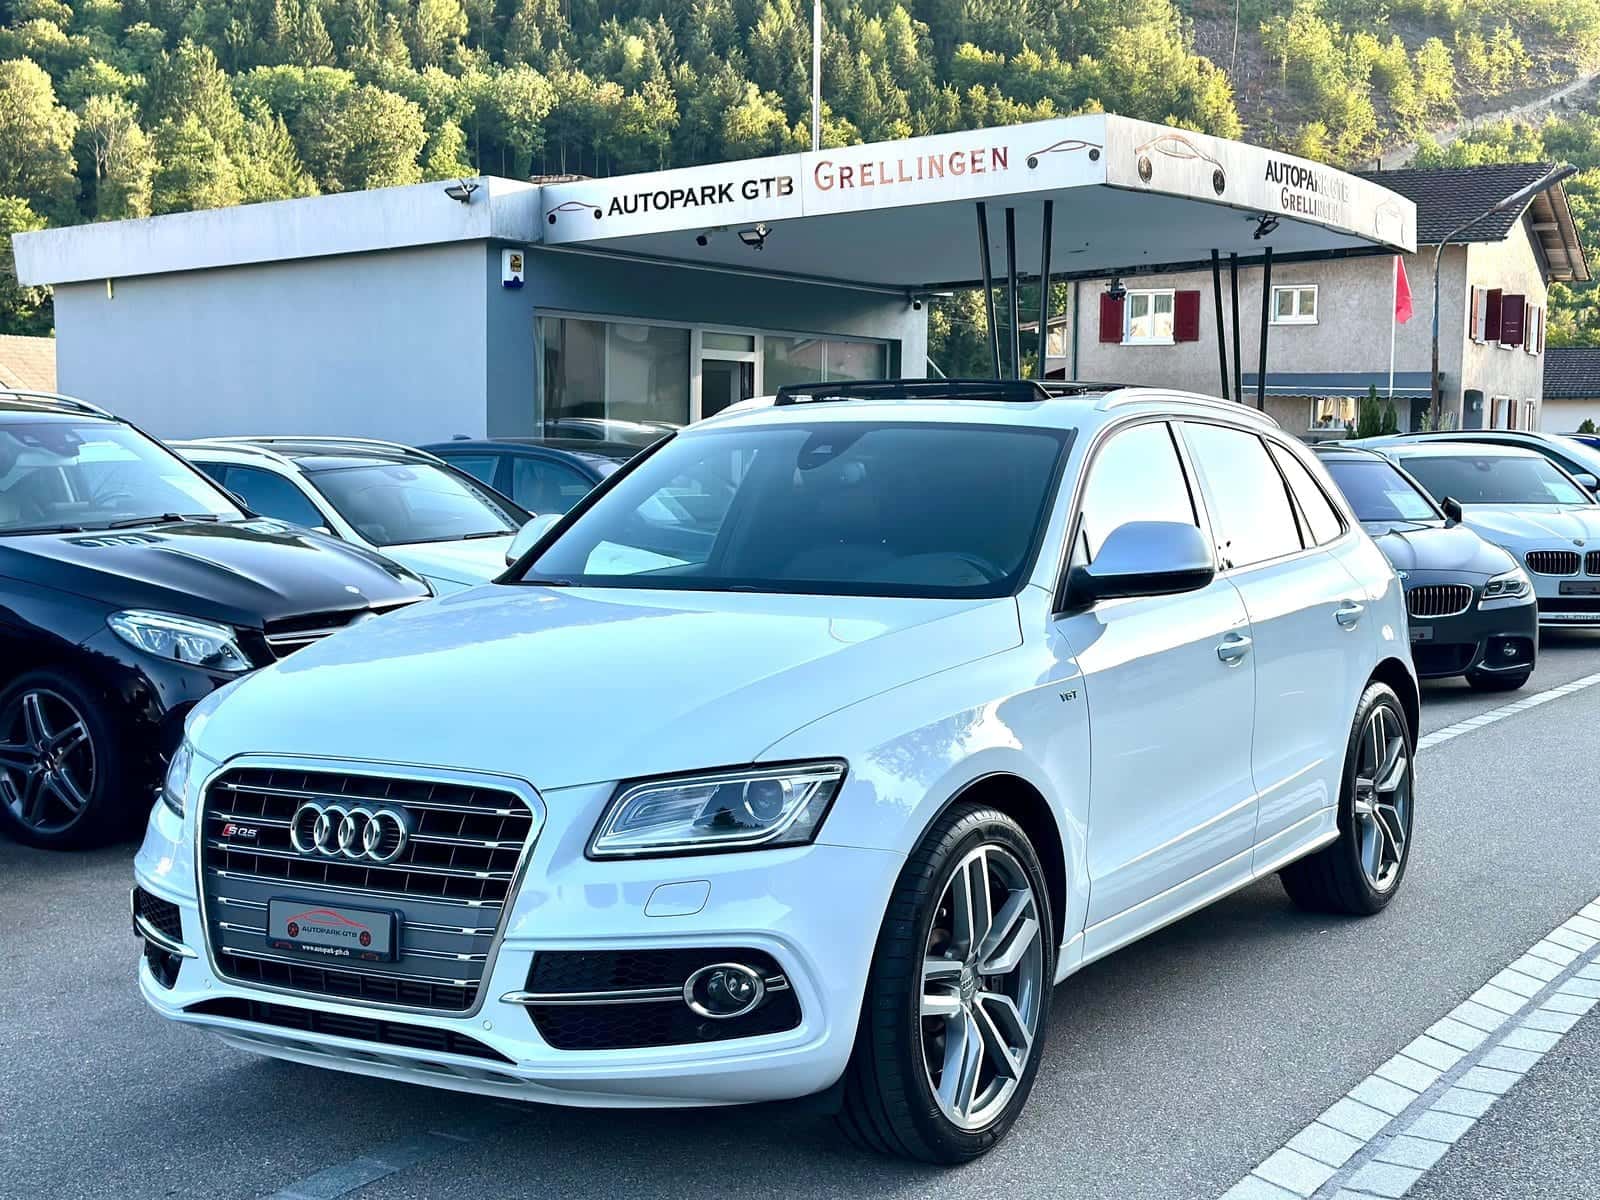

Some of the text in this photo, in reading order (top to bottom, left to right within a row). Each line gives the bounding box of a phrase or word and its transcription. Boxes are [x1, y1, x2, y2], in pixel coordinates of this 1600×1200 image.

[607, 146, 1009, 217] AUTOPARK GTB GRELLINGEN
[226, 825, 258, 837] SQ5
